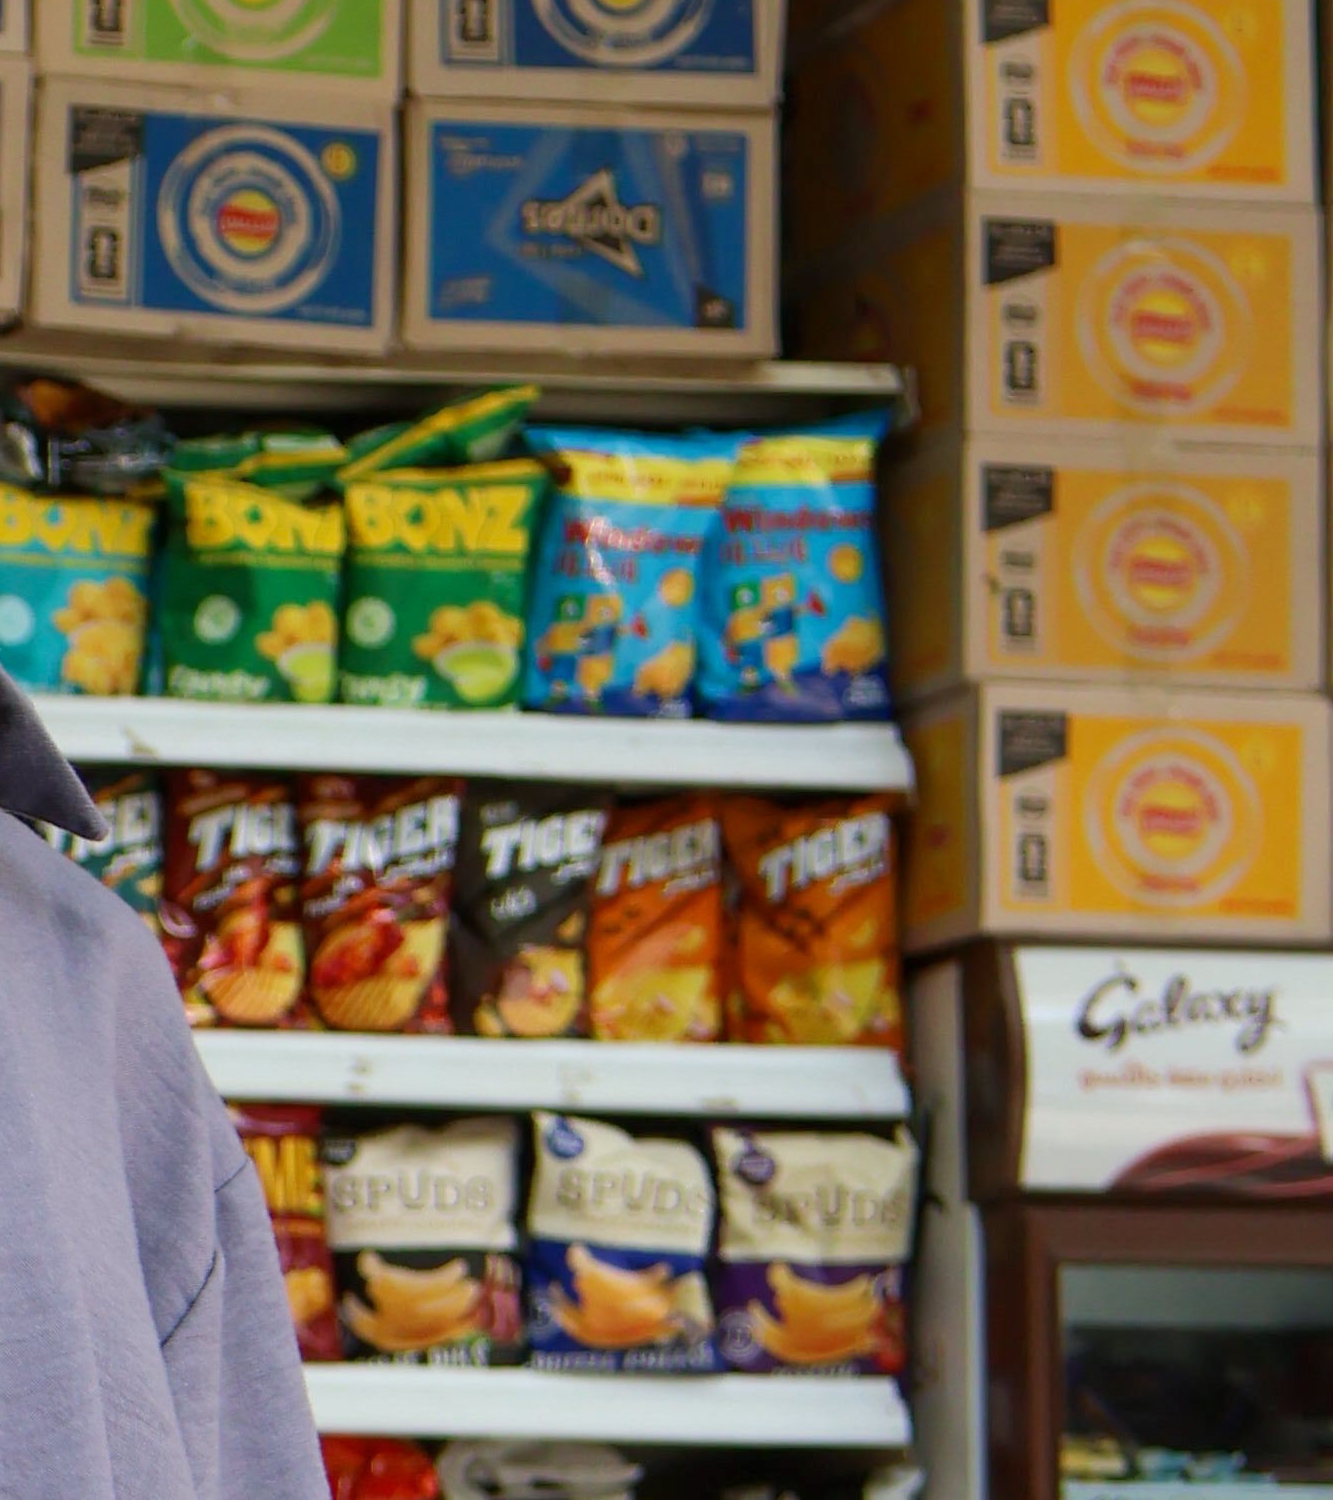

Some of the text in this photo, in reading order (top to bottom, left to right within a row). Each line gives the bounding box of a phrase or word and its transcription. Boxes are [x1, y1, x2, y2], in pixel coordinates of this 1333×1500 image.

[185, 480, 346, 556] BONZ
[344, 481, 533, 553] BONZ
[304, 794, 460, 876] TIGER
[1073, 970, 1278, 1053] Galaxy
[332, 1172, 496, 1214] SPUDS
[555, 1168, 717, 1217] SPUDS
